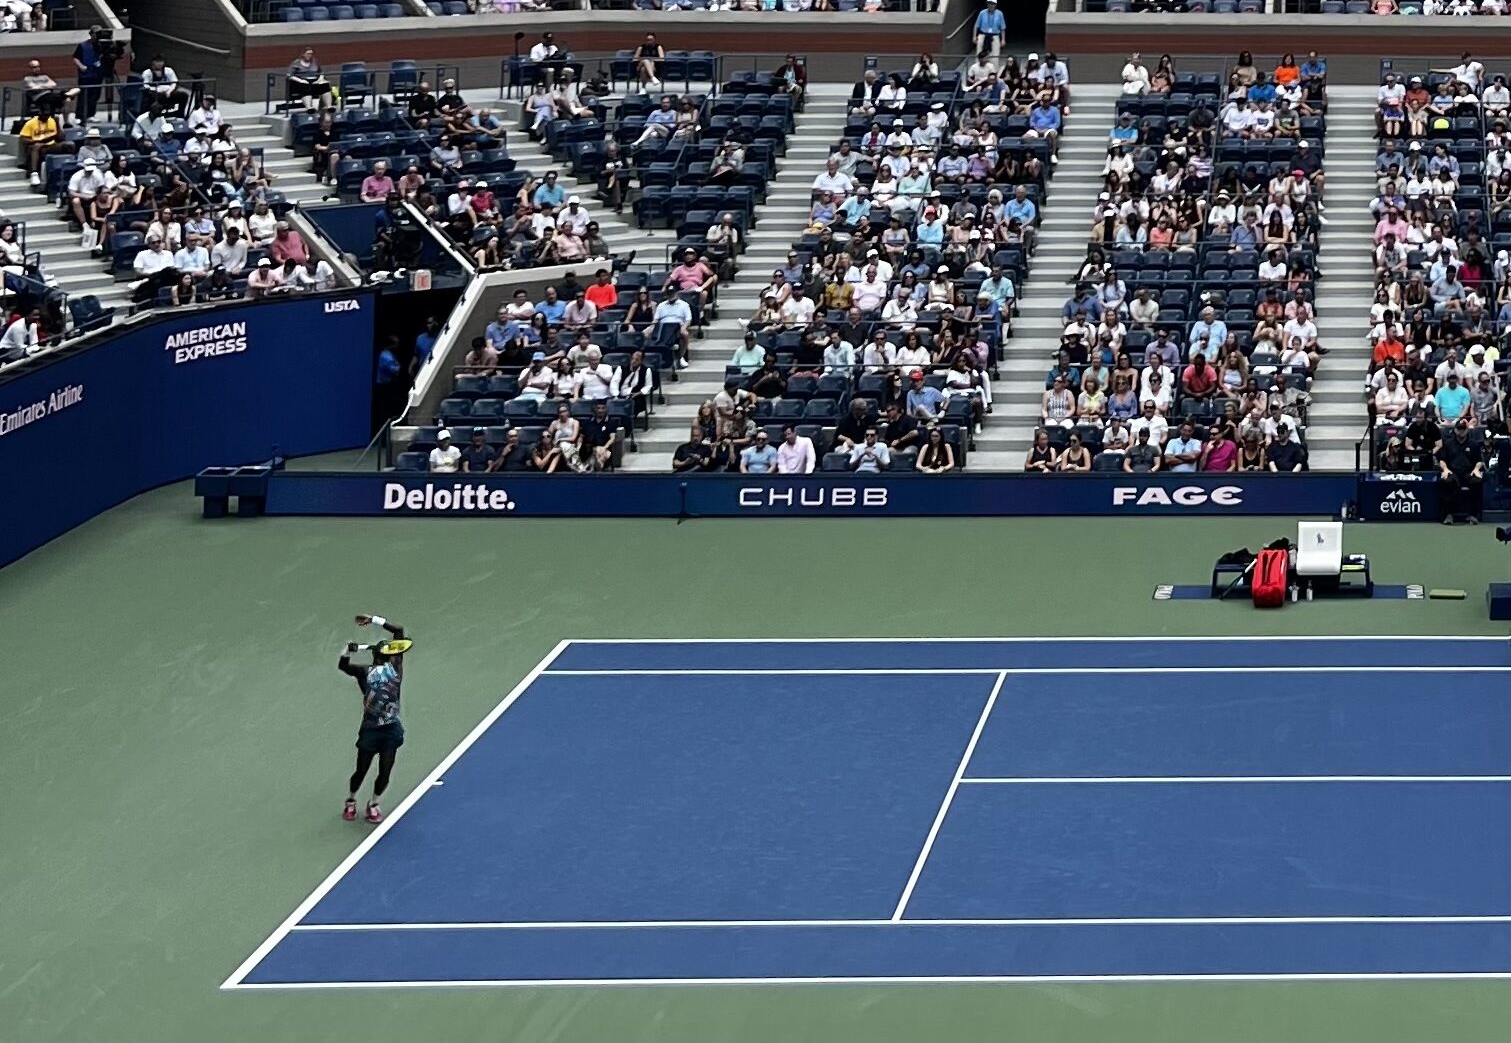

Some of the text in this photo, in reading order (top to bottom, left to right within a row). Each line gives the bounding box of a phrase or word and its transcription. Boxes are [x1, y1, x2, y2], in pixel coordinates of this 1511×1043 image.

[324, 299, 360, 313] USTA
[165, 322, 246, 350] AMERICAN
[175, 337, 247, 364] EXPRESS
[0, 384, 83, 436] Emirates Airline
[383, 483, 516, 510] Deloitte.
[739, 487, 888, 507] CHUBB
[1380, 499, 1421, 513] evian
